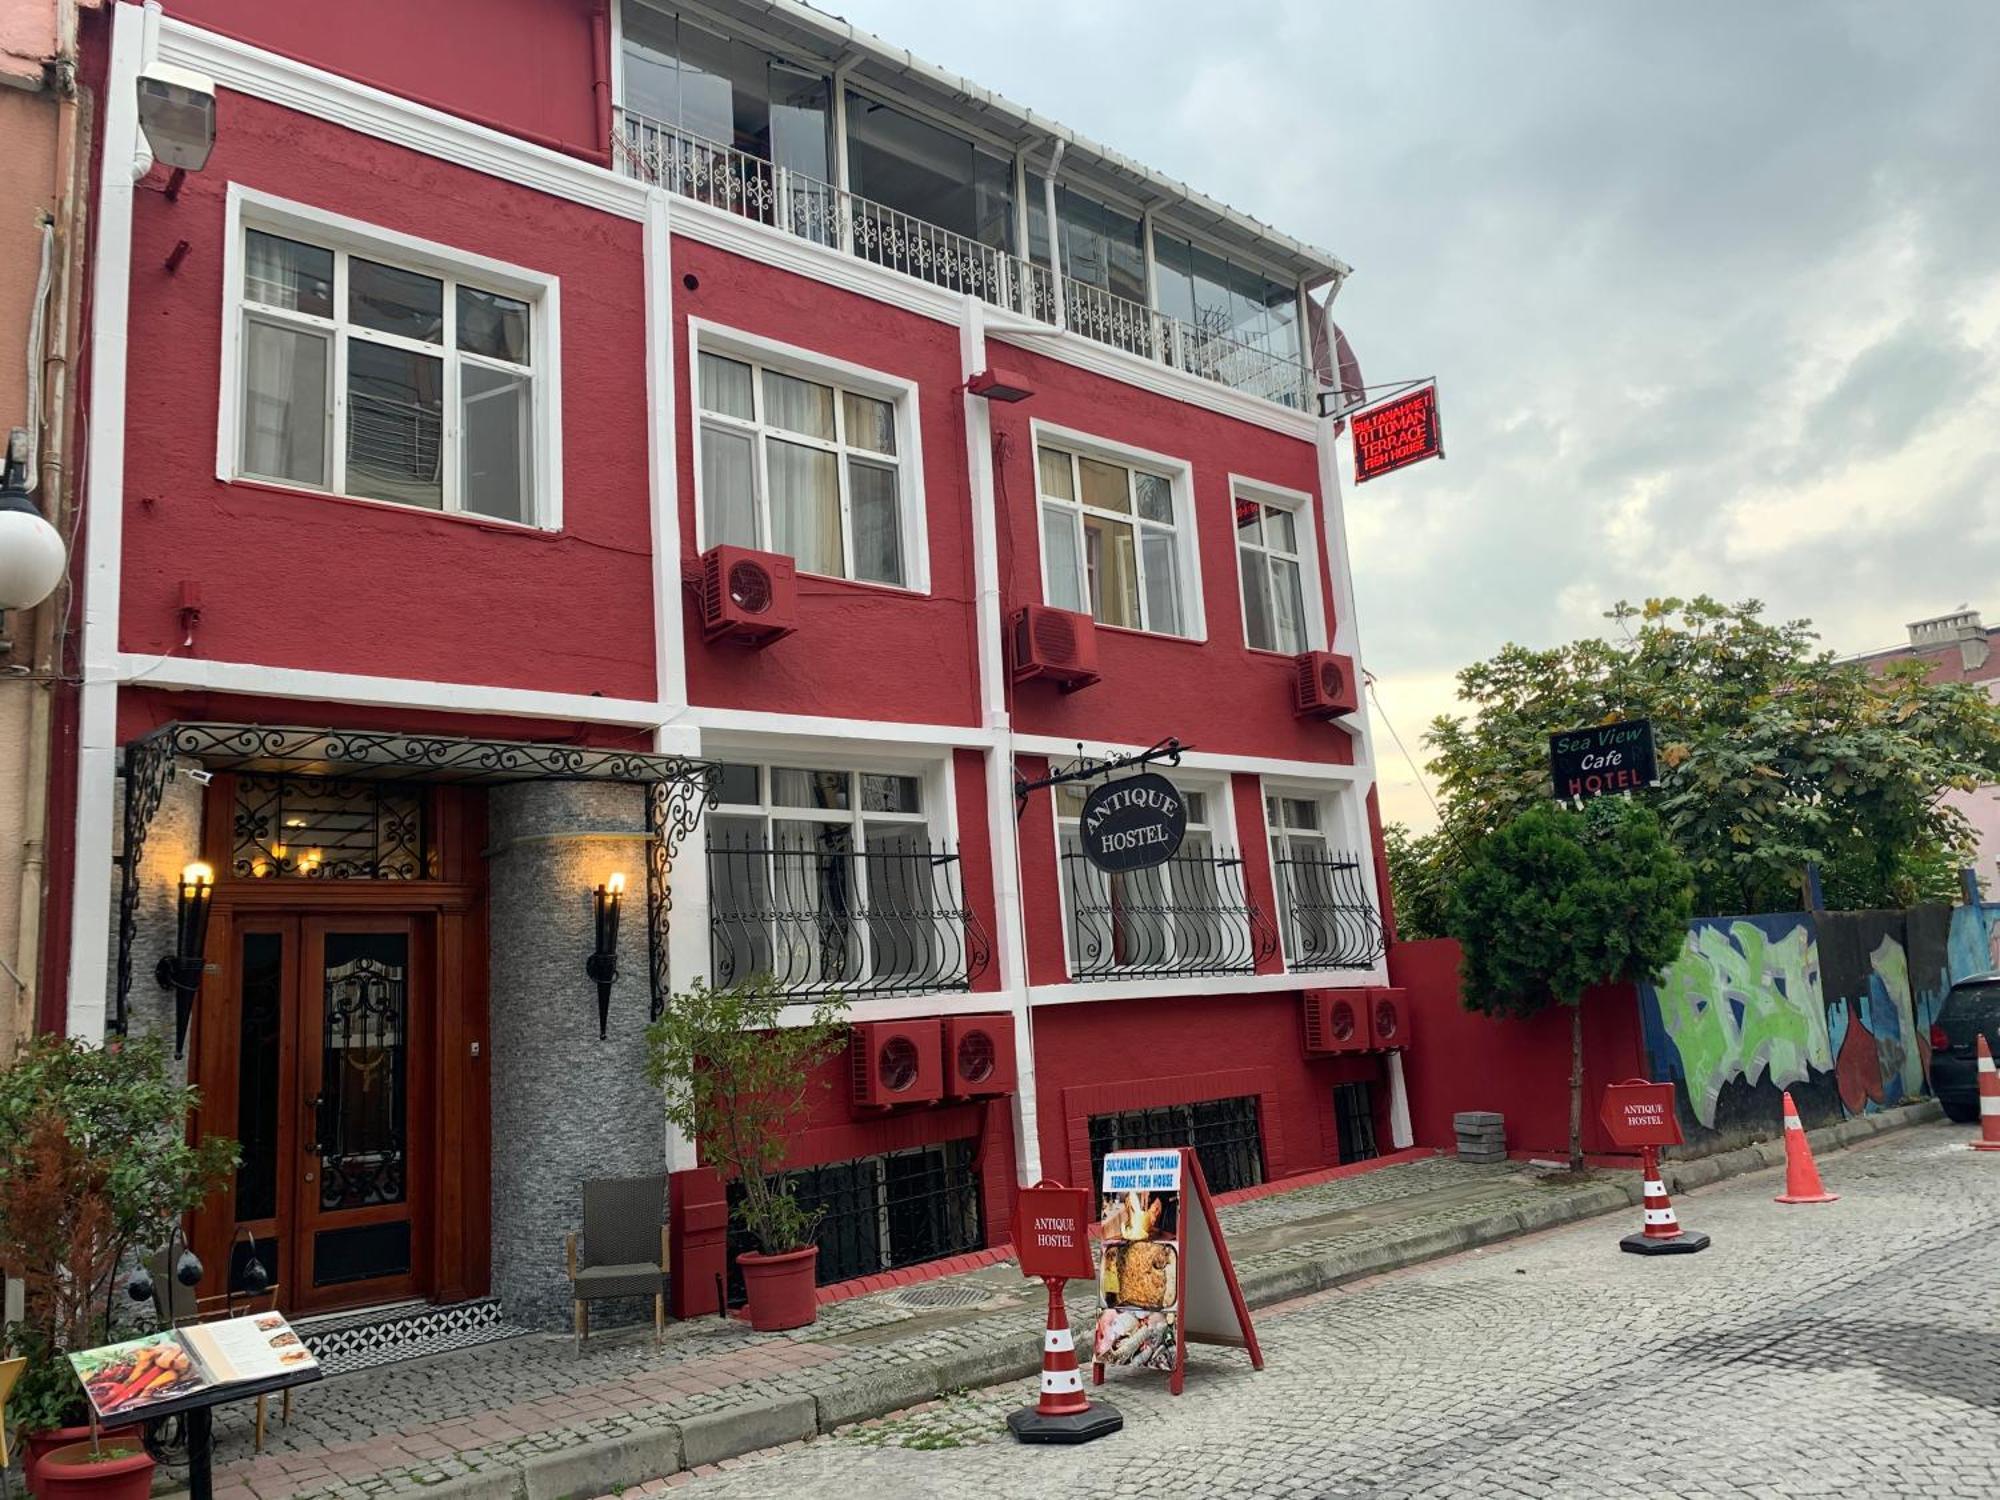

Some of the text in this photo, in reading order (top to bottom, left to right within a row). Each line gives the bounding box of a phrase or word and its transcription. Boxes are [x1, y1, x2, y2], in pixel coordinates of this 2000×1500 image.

[1354, 396, 1429, 433] SULTANAHMET
[1359, 408, 1426, 445] OTTOMAN
[1361, 423, 1427, 458] TERRACE
[1364, 439, 1426, 471] FISH HOUSE
[1557, 727, 1643, 753] Sea View
[1581, 750, 1622, 770] Cafe
[1569, 768, 1642, 796] HOTEL
[1086, 787, 1178, 836] ANTIQUE
[1101, 823, 1169, 853] HOSTEL
[1623, 1103, 1665, 1115] ANTIQUE
[1627, 1115, 1664, 1126] HOSTEL
[1149, 1155, 1180, 1170] OTTOMAN
[1111, 1174, 1174, 1189] TERRACE FISH HOUSE
[1034, 1217, 1076, 1231] ANTIQUE
[1038, 1234, 1074, 1247] HOSTEL
